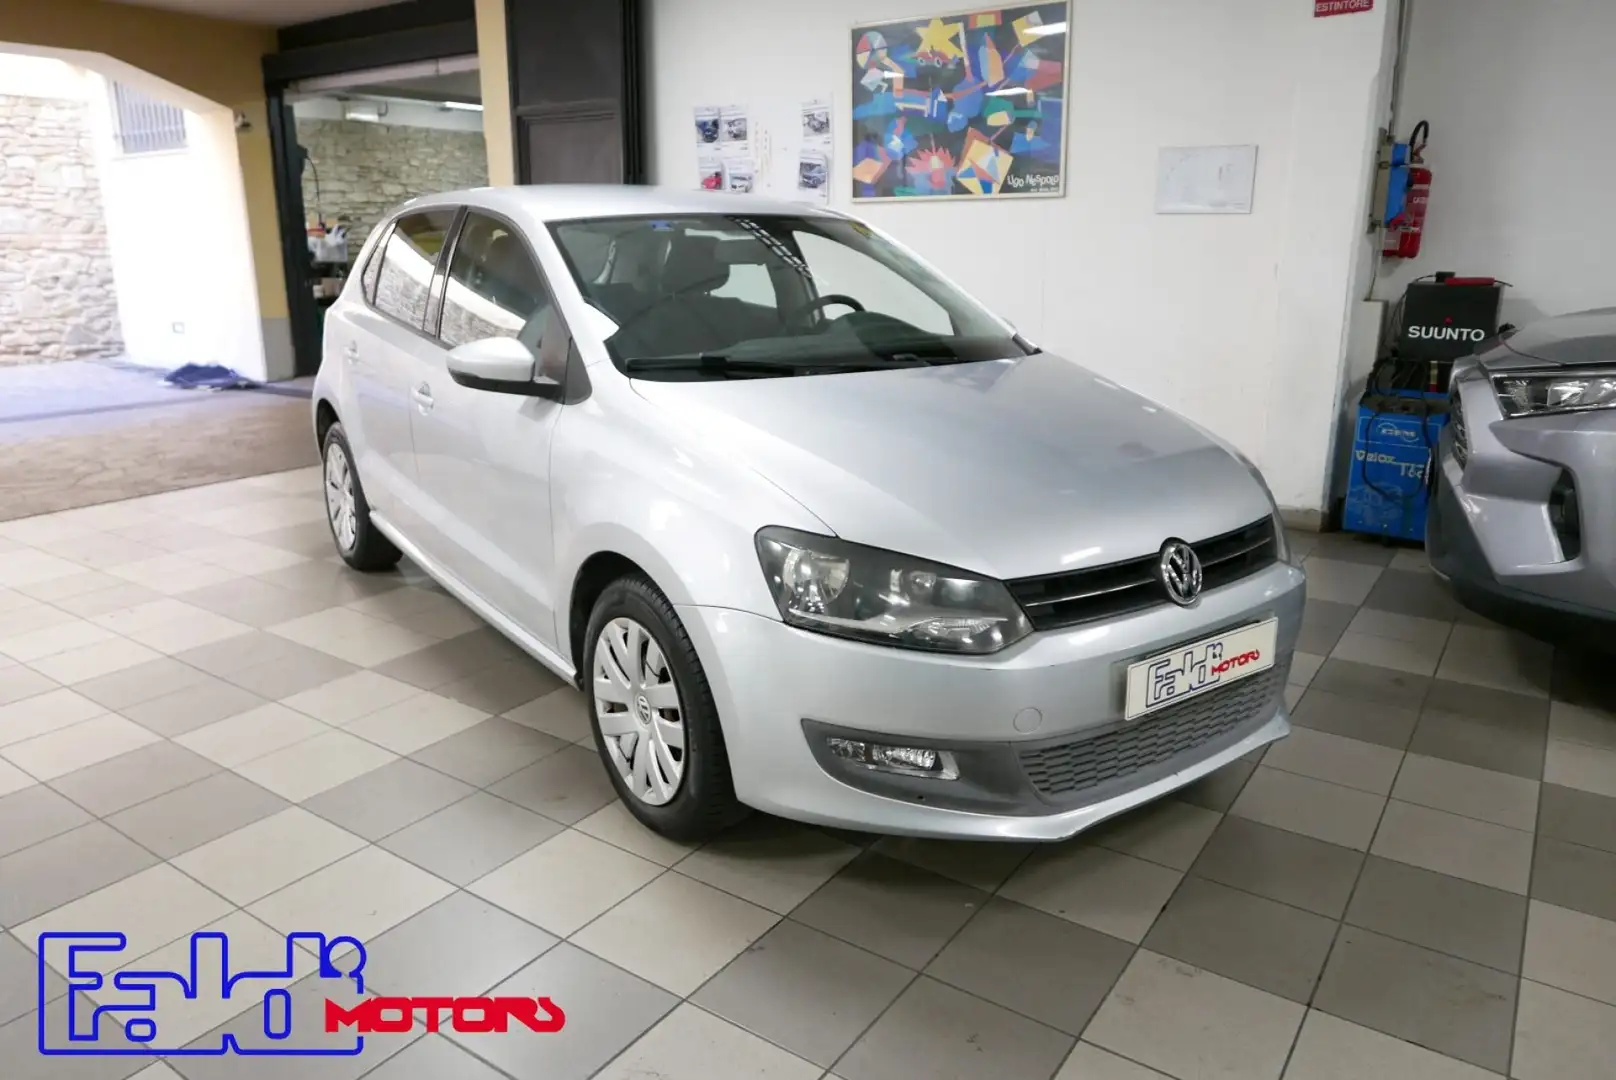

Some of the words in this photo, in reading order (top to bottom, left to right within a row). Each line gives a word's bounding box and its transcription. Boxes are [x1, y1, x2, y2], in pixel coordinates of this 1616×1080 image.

[1316, 0, 1370, 12] ESTINTORE
[1007, 174, 1024, 188] Ugo
[1407, 325, 1485, 341] SUUNTO
